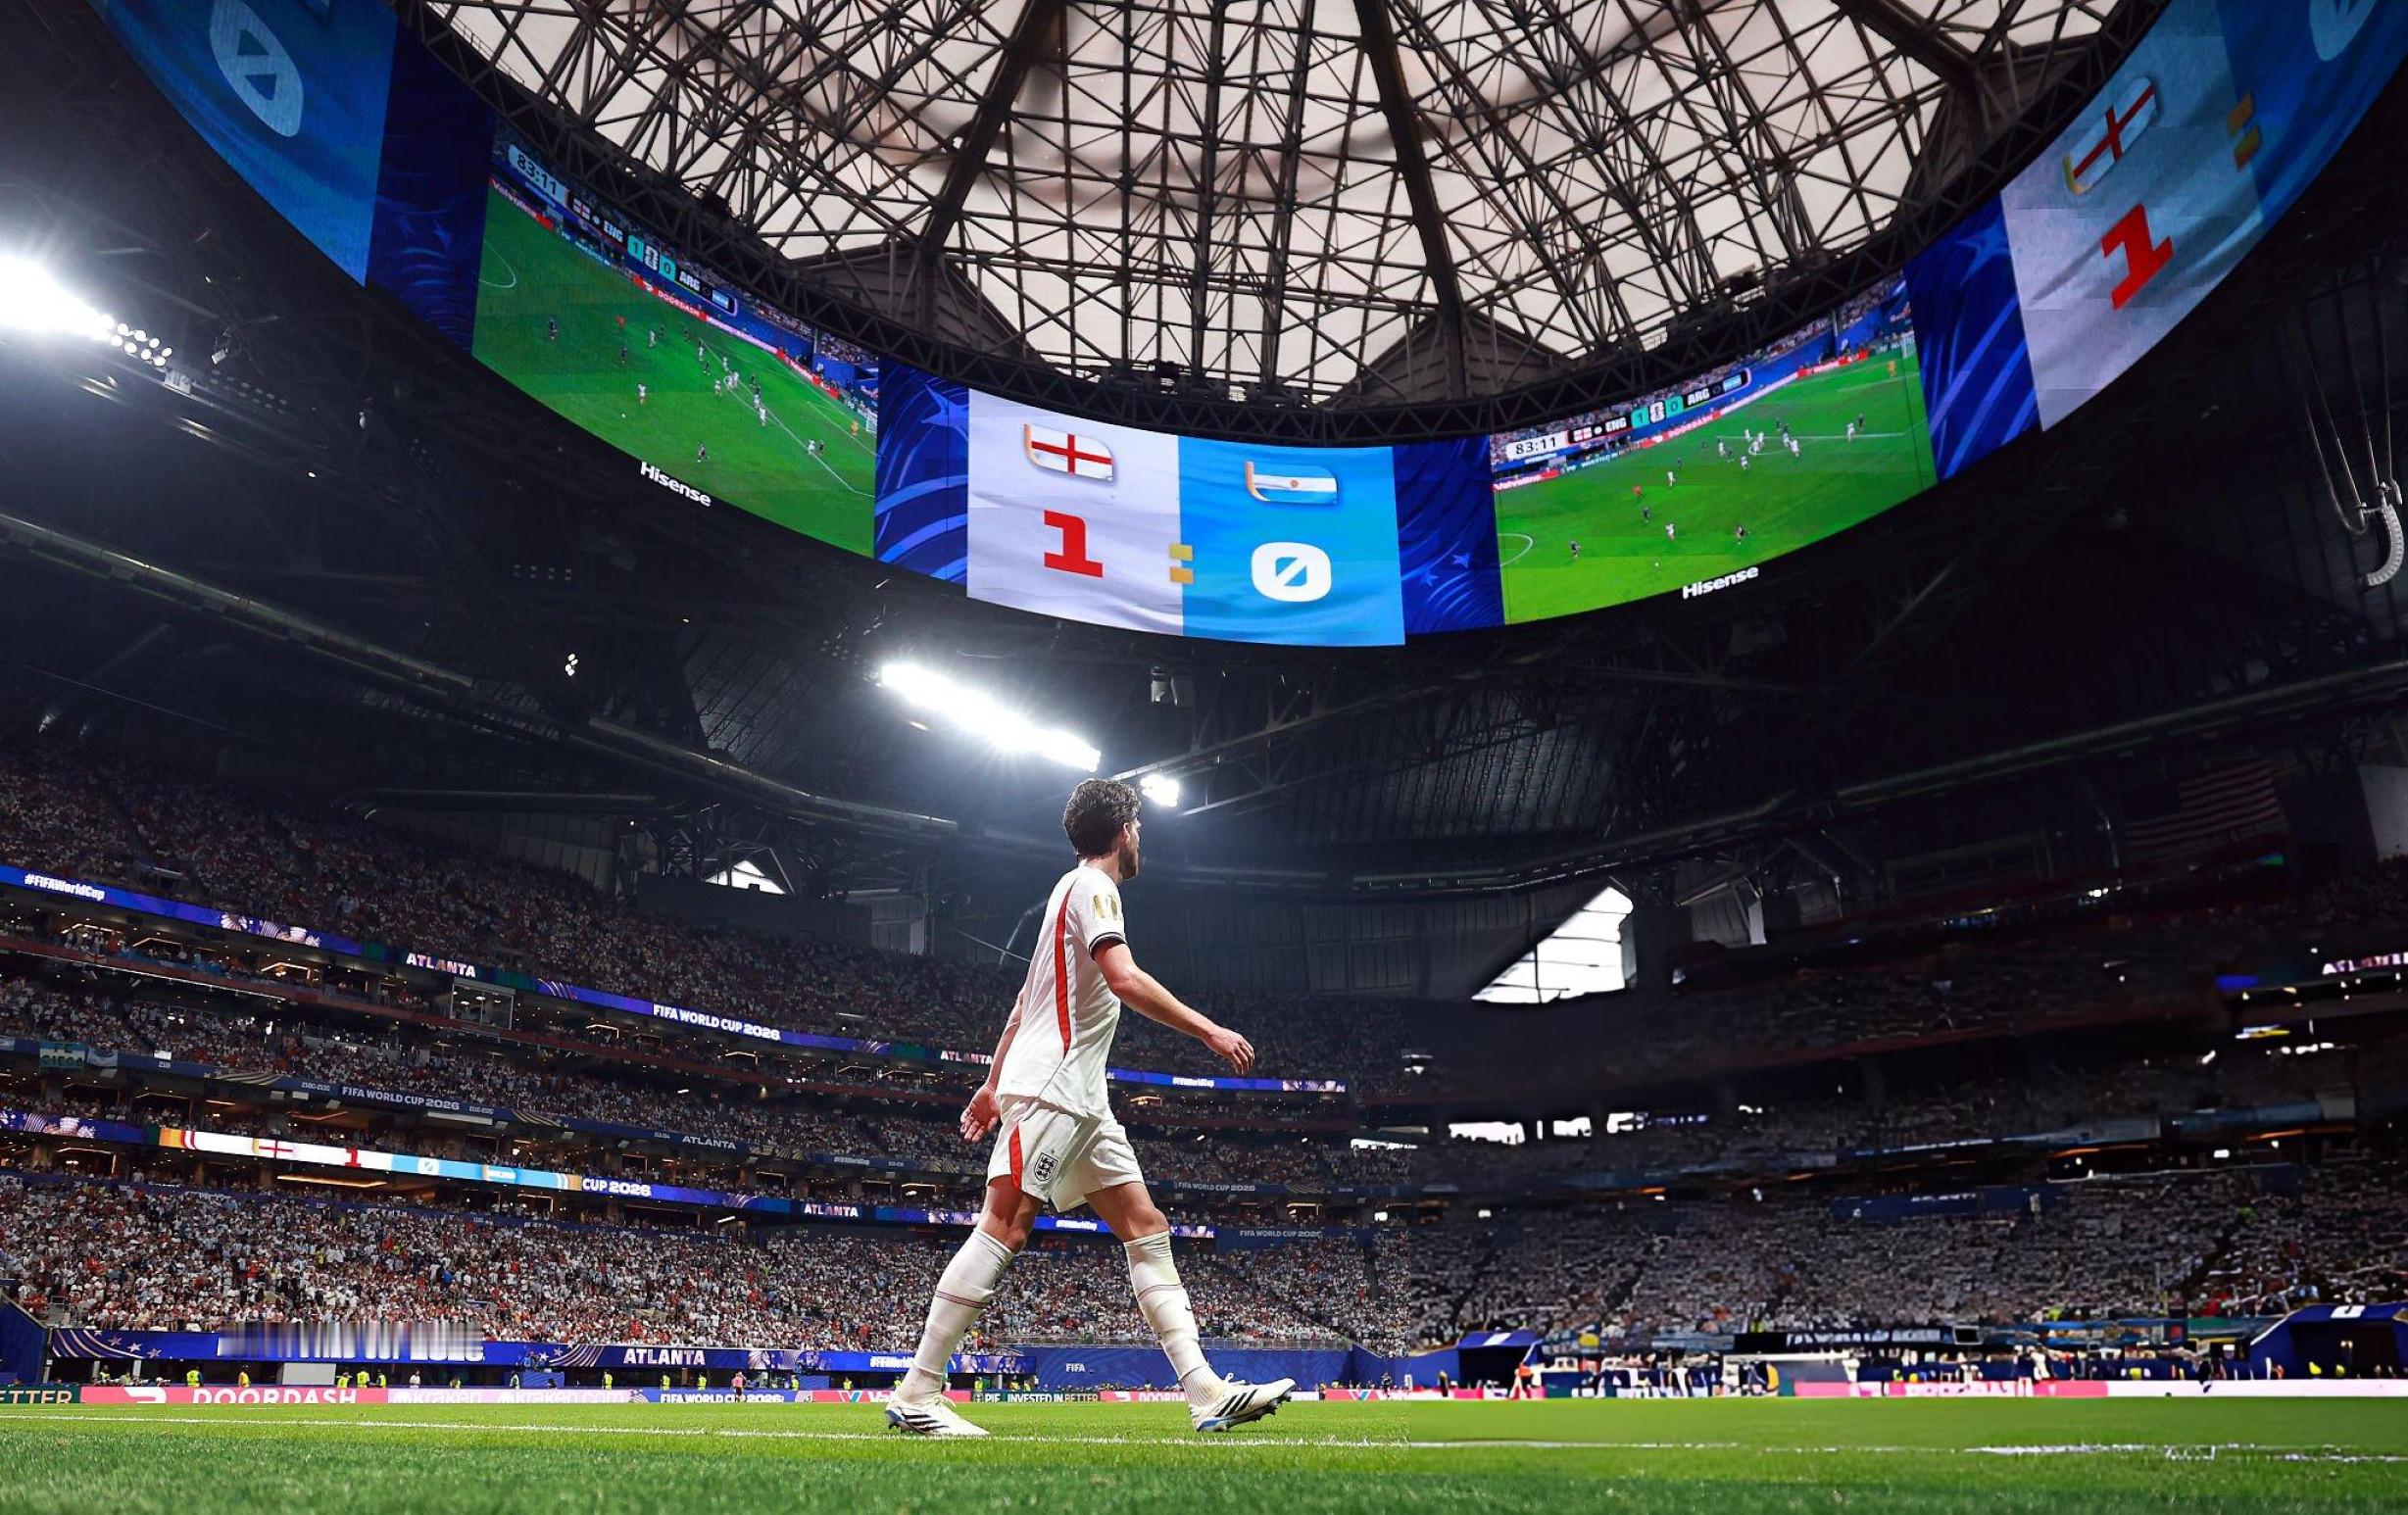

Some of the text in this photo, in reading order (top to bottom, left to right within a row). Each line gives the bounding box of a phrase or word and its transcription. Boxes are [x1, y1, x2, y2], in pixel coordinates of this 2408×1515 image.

[516, 153, 557, 196] 83:11
[603, 220, 624, 243] ENG
[678, 270, 701, 291] ARG
[2100, 203, 2175, 311] 1
[1515, 436, 1556, 455] 83:11
[1605, 416, 1627, 432] ENG
[1687, 388, 1710, 406] ARG
[640, 461, 712, 508] Hisense
[1044, 510, 1104, 578] 1
[1251, 541, 1332, 603] 0
[1682, 566, 1759, 600] Hisense
[25, 873, 106, 902] #FIFAWorldCup
[406, 953, 476, 978] ATLANTA
[653, 1003, 781, 1041] FIFA WORLD CUP 2026
[940, 1050, 993, 1065] ATLANTA
[342, 1086, 366, 1099] FIFA
[367, 1090, 404, 1103] WORLD
[404, 1096, 425, 1106] CUP
[425, 1099, 460, 1110] 2026
[682, 1136, 737, 1150] ATLANTA
[344, 1148, 362, 1167] 1
[582, 1178, 652, 1197] CUP 2026
[804, 1203, 859, 1217] ATLANTA
[622, 1348, 706, 1365] ATLANTA
[1065, 1363, 1086, 1373] FIFA
